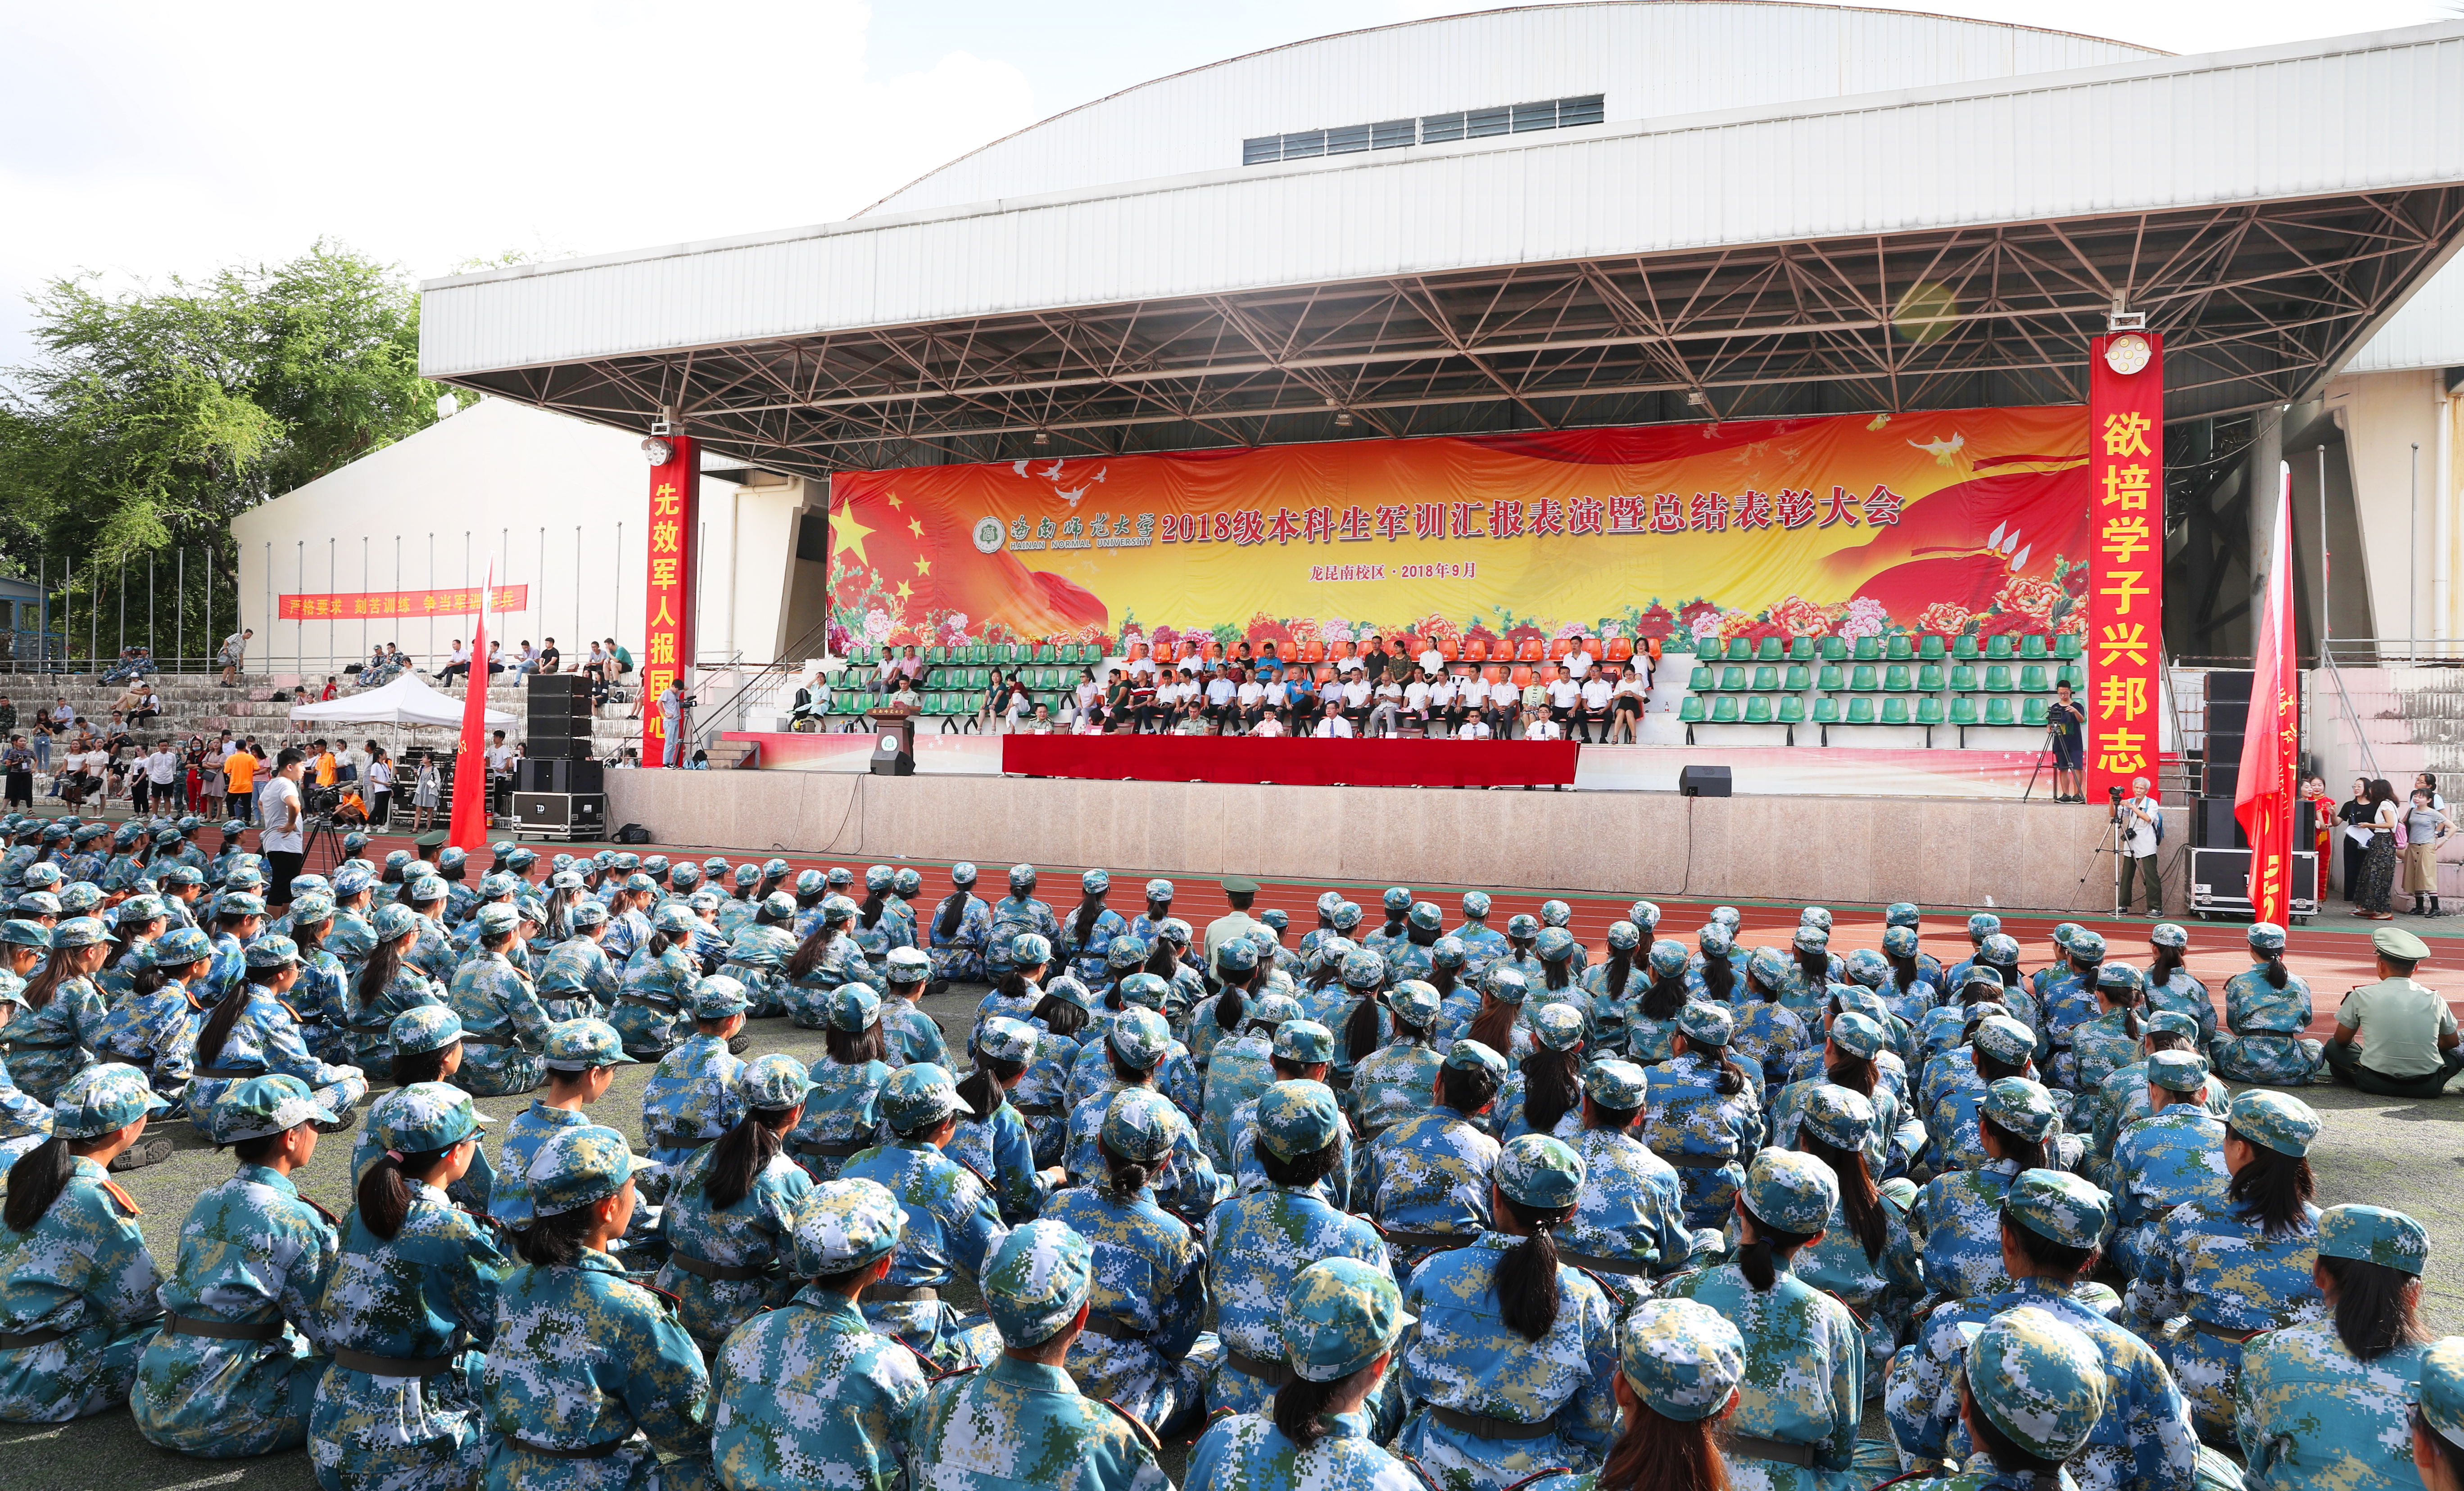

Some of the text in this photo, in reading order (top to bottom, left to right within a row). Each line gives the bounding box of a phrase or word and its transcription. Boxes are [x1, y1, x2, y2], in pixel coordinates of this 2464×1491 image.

[1010, 513, 1155, 540] 海南师范大学
[1161, 483, 1904, 545] 2018级本科生军训汇报表演暨总结表彰大会
[1010, 537, 1153, 550] HAINAN NORMAL UNIVERSITY
[290, 598, 342, 615] 严格要求
[354, 596, 411, 614] 刻苦训练
[648, 483, 679, 739] 先效军人报国心
[2097, 411, 2152, 774] 欲培学子兴邦志
